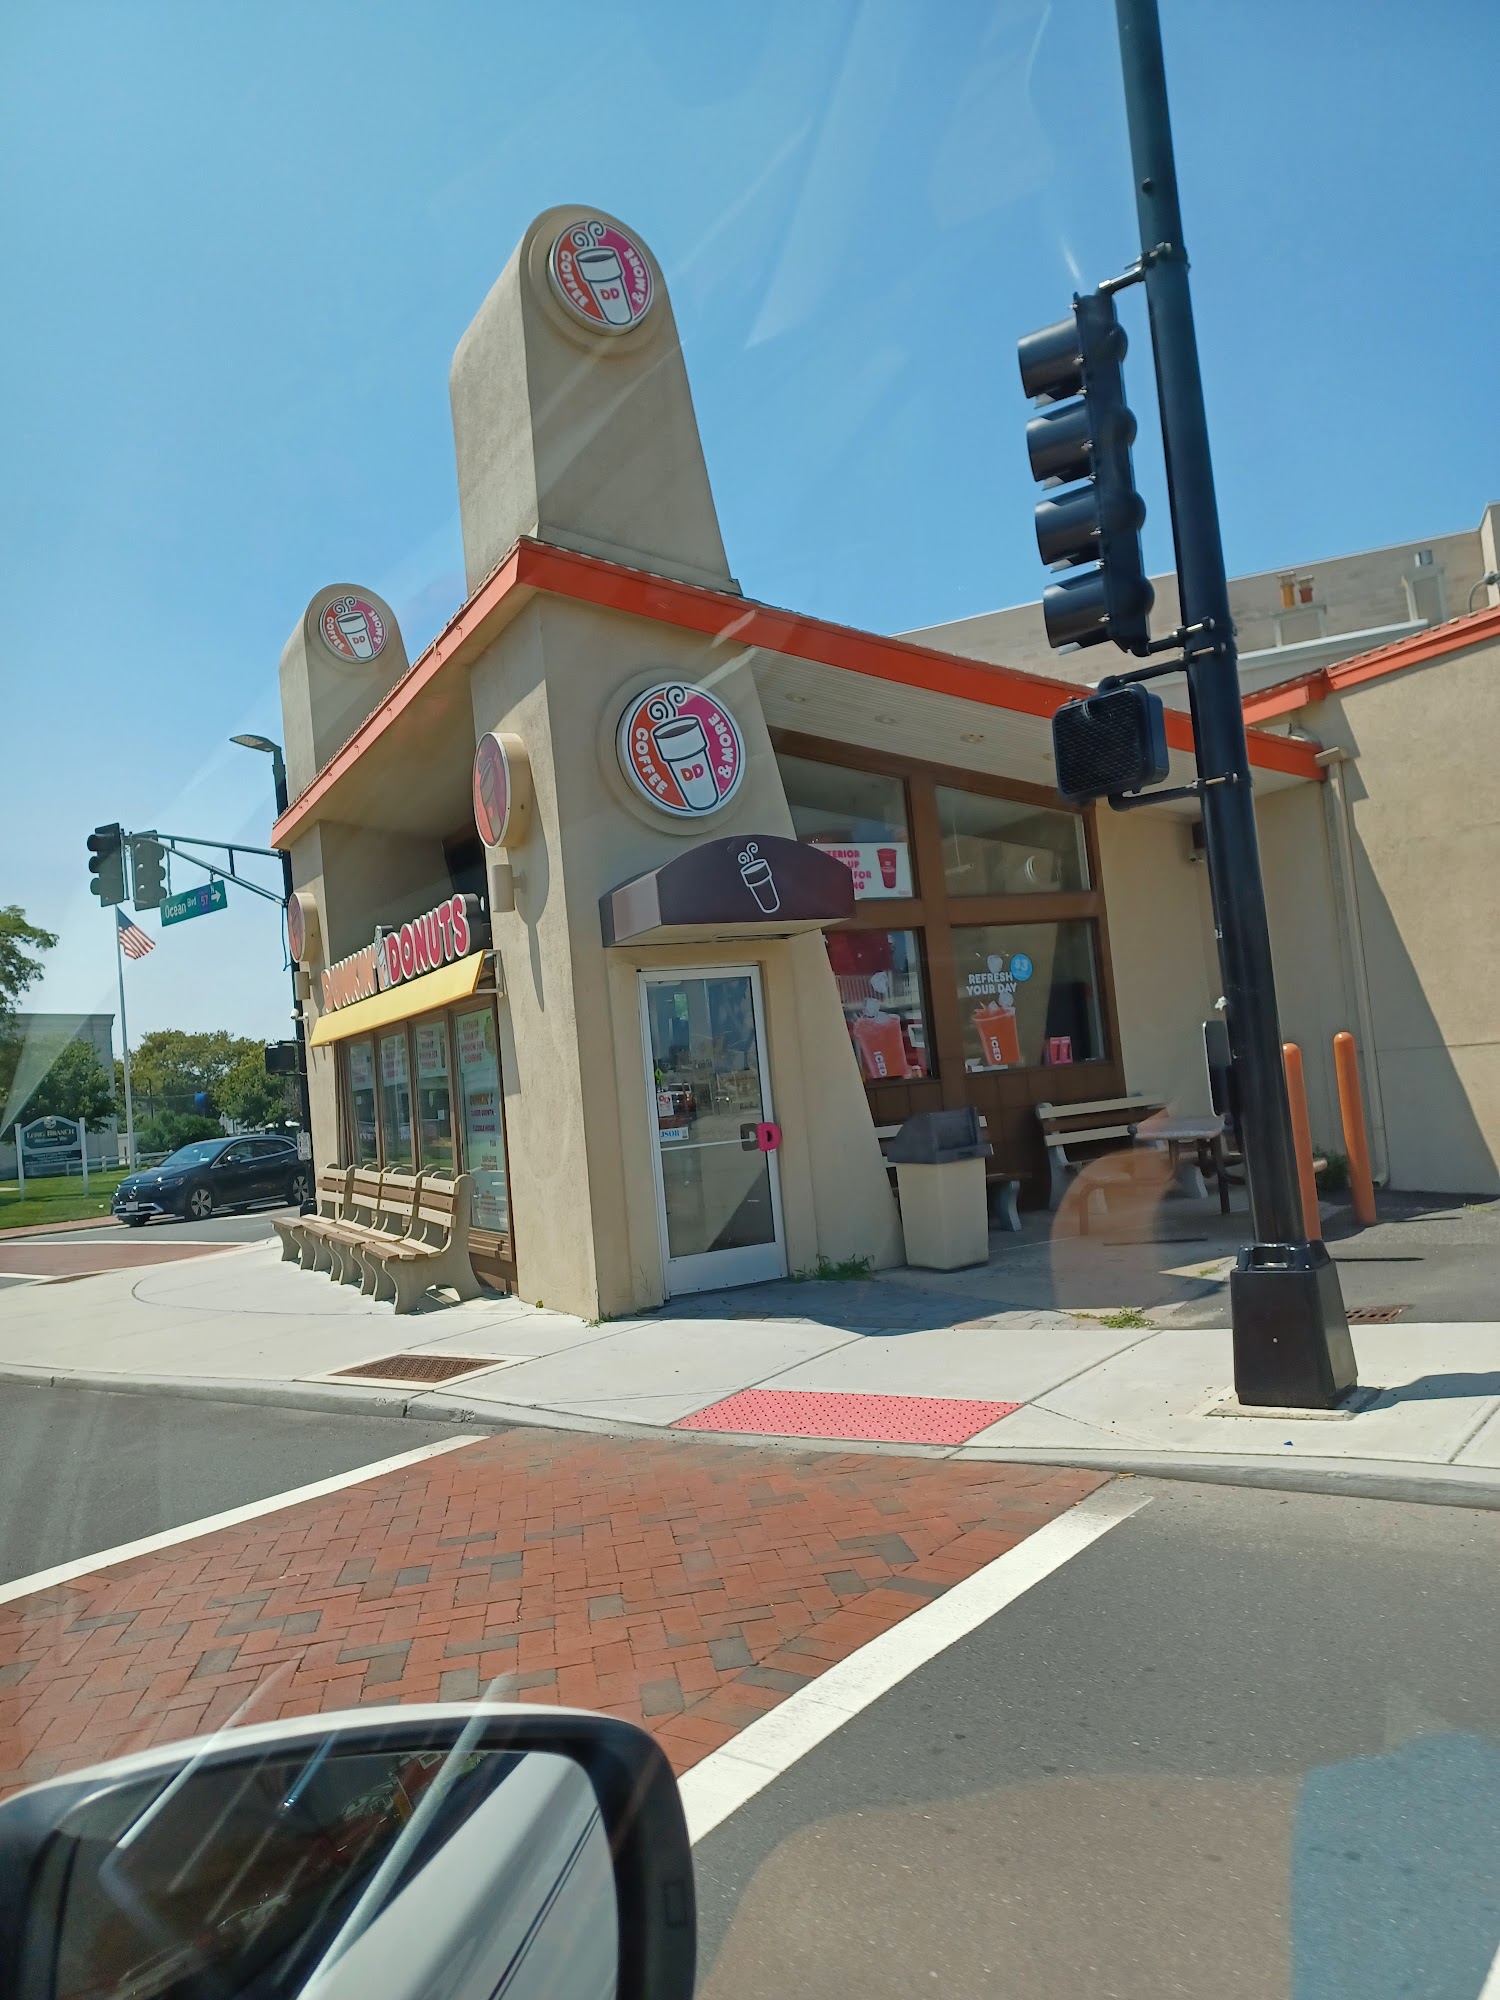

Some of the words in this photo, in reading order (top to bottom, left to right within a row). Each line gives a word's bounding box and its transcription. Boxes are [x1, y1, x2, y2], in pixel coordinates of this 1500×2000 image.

[560, 250, 588, 307] COFFEE
[623, 248, 647, 293] MORE
[601, 288, 619, 300] DD
[326, 616, 345, 650] COFFEE
[352, 636, 366, 644] DD
[708, 713, 733, 763] MORE
[636, 728, 667, 794] COFFEE
[681, 763, 703, 781] DD
[717, 765, 733, 779] &
[825, 849, 860, 858] TERIOR
[164, 902, 187, 919] Ocean
[187, 896, 197, 907] Blvd
[386, 893, 470, 985] DONUTS
[1014, 959, 1029, 972] $3
[968, 972, 1014, 985] REFRESH
[966, 984, 996, 997] YOUR
[997, 982, 1018, 994] DAY
[990, 1036, 1002, 1062] ICED
[873, 1051, 888, 1077] ICED
[47, 1129, 74, 1137] BRANCH
